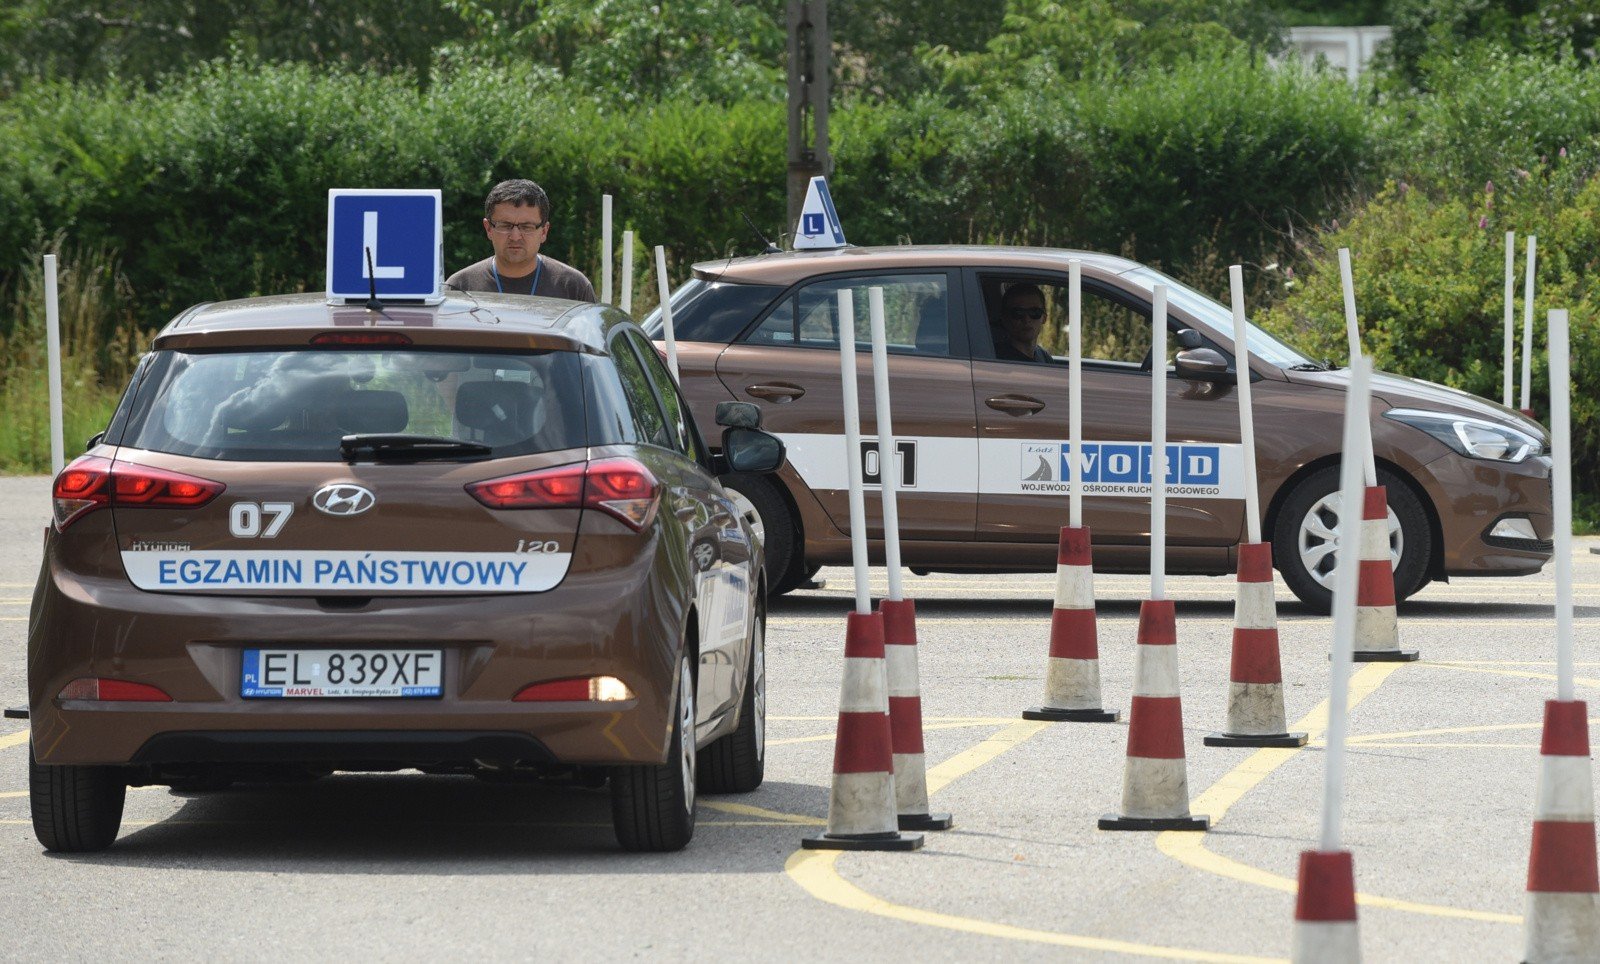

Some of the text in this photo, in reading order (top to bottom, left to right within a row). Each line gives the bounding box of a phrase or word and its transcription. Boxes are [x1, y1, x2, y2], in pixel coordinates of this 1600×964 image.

[809, 217, 819, 232] L
[362, 211, 405, 279] L
[857, 439, 918, 488] 01
[1021, 483, 1220, 495] WOJEWÓDZ OŚRODEK RUCH ROGOWEGO
[229, 502, 295, 539] 07
[515, 539, 560, 555] i20
[159, 553, 528, 585] EGZAMIN PAŃSTWOWY
[245, 673, 257, 683] PL
[264, 653, 434, 686] EL 839XF
